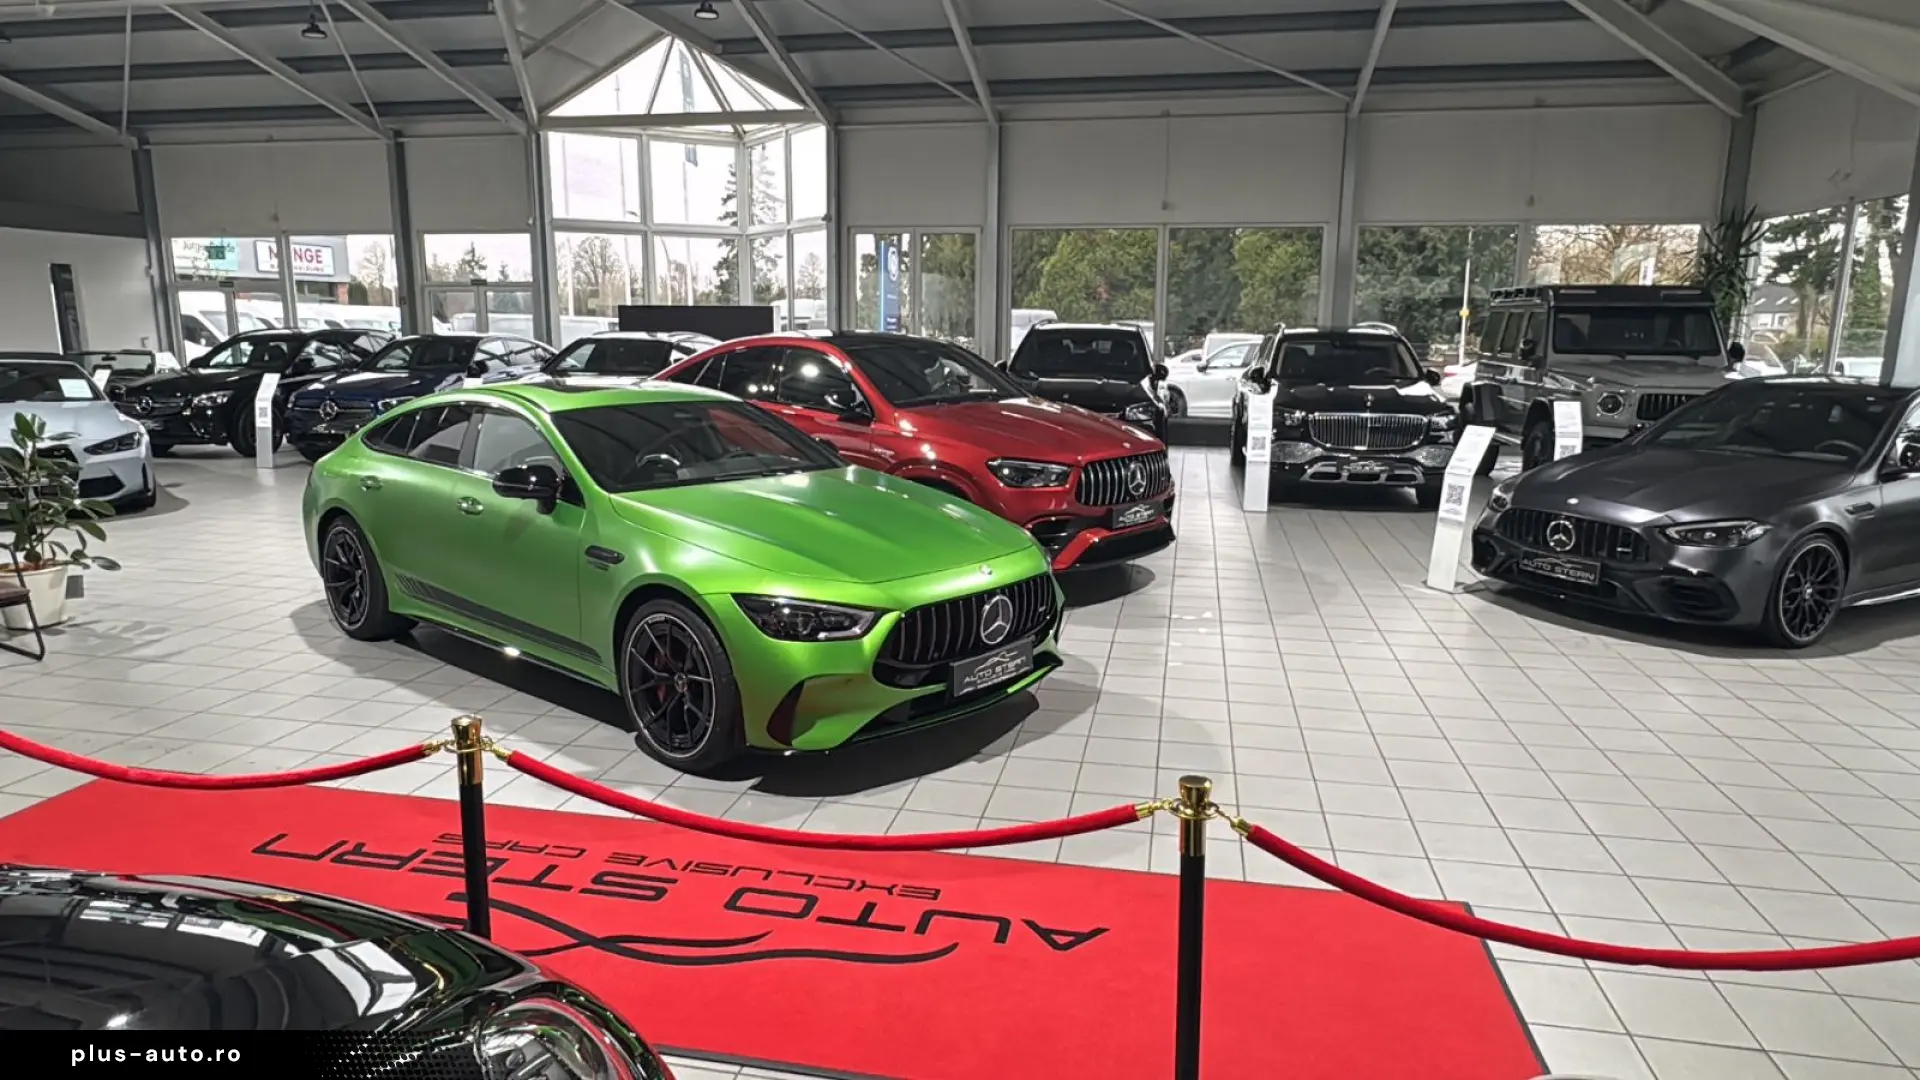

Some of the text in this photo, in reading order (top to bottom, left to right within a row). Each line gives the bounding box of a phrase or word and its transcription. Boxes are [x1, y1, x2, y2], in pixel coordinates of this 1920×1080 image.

[268, 245, 323, 264] MNGE
[1521, 558, 1595, 581] AUTO STERN
[963, 668, 992, 683] AUTO
[603, 851, 942, 901] EXCLUSIVE
[251, 833, 1111, 951] AUTO STERN
